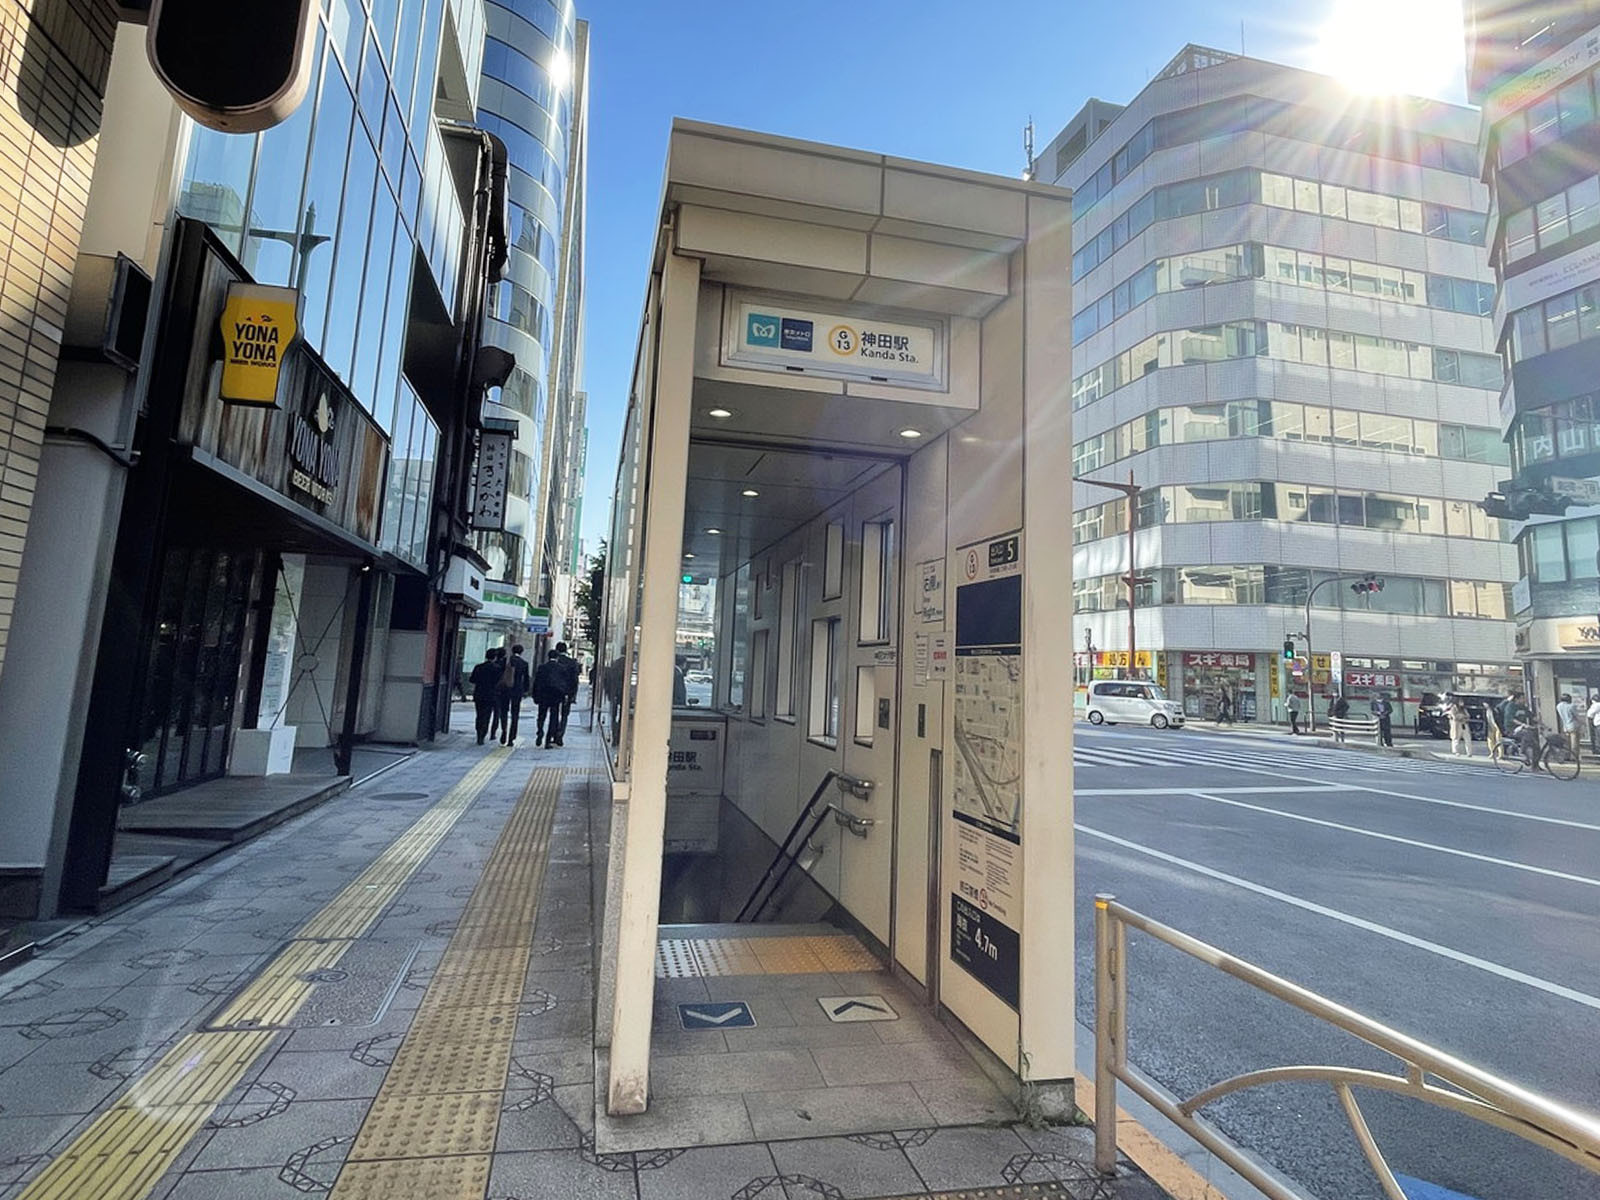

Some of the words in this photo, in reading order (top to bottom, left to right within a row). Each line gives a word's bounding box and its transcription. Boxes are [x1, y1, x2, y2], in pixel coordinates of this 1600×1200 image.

[235, 322, 278, 344] YONA
[839, 330, 848, 340] G
[861, 331, 909, 351] 神田駅
[232, 341, 276, 362] YONA
[837, 340, 850, 350] 13
[861, 347, 896, 361] Kanda
[898, 352, 919, 364] Sta.
[1533, 424, 1600, 460] 内山
[1007, 540, 1014, 560] 5
[1188, 653, 1250, 667] スギ薬局
[1350, 673, 1395, 686] スギ薬局
[974, 927, 998, 960] 4.7m
